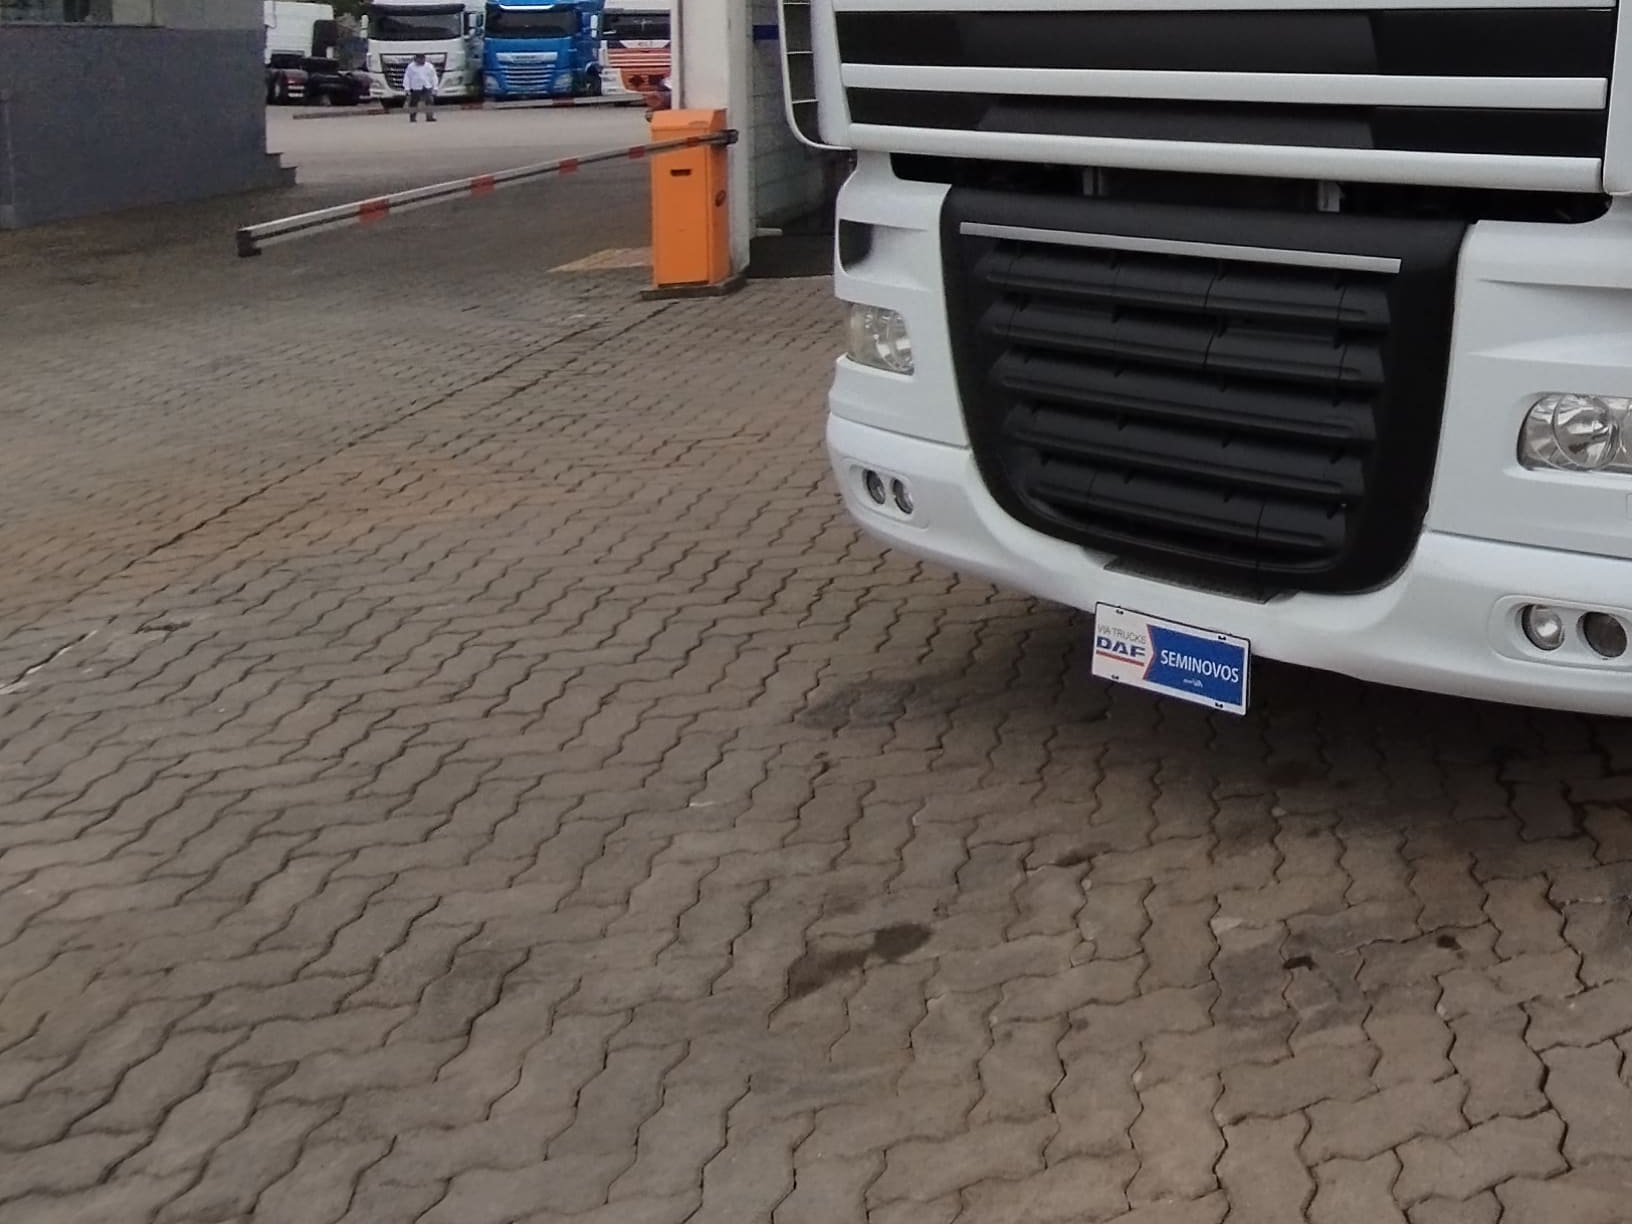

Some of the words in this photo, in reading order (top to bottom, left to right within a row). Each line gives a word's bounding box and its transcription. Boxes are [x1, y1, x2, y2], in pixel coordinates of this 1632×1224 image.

[1096, 636, 1146, 658] DAF
[1112, 628, 1147, 644] TRUCKS
[1160, 649, 1239, 683] SEMINOVOS
